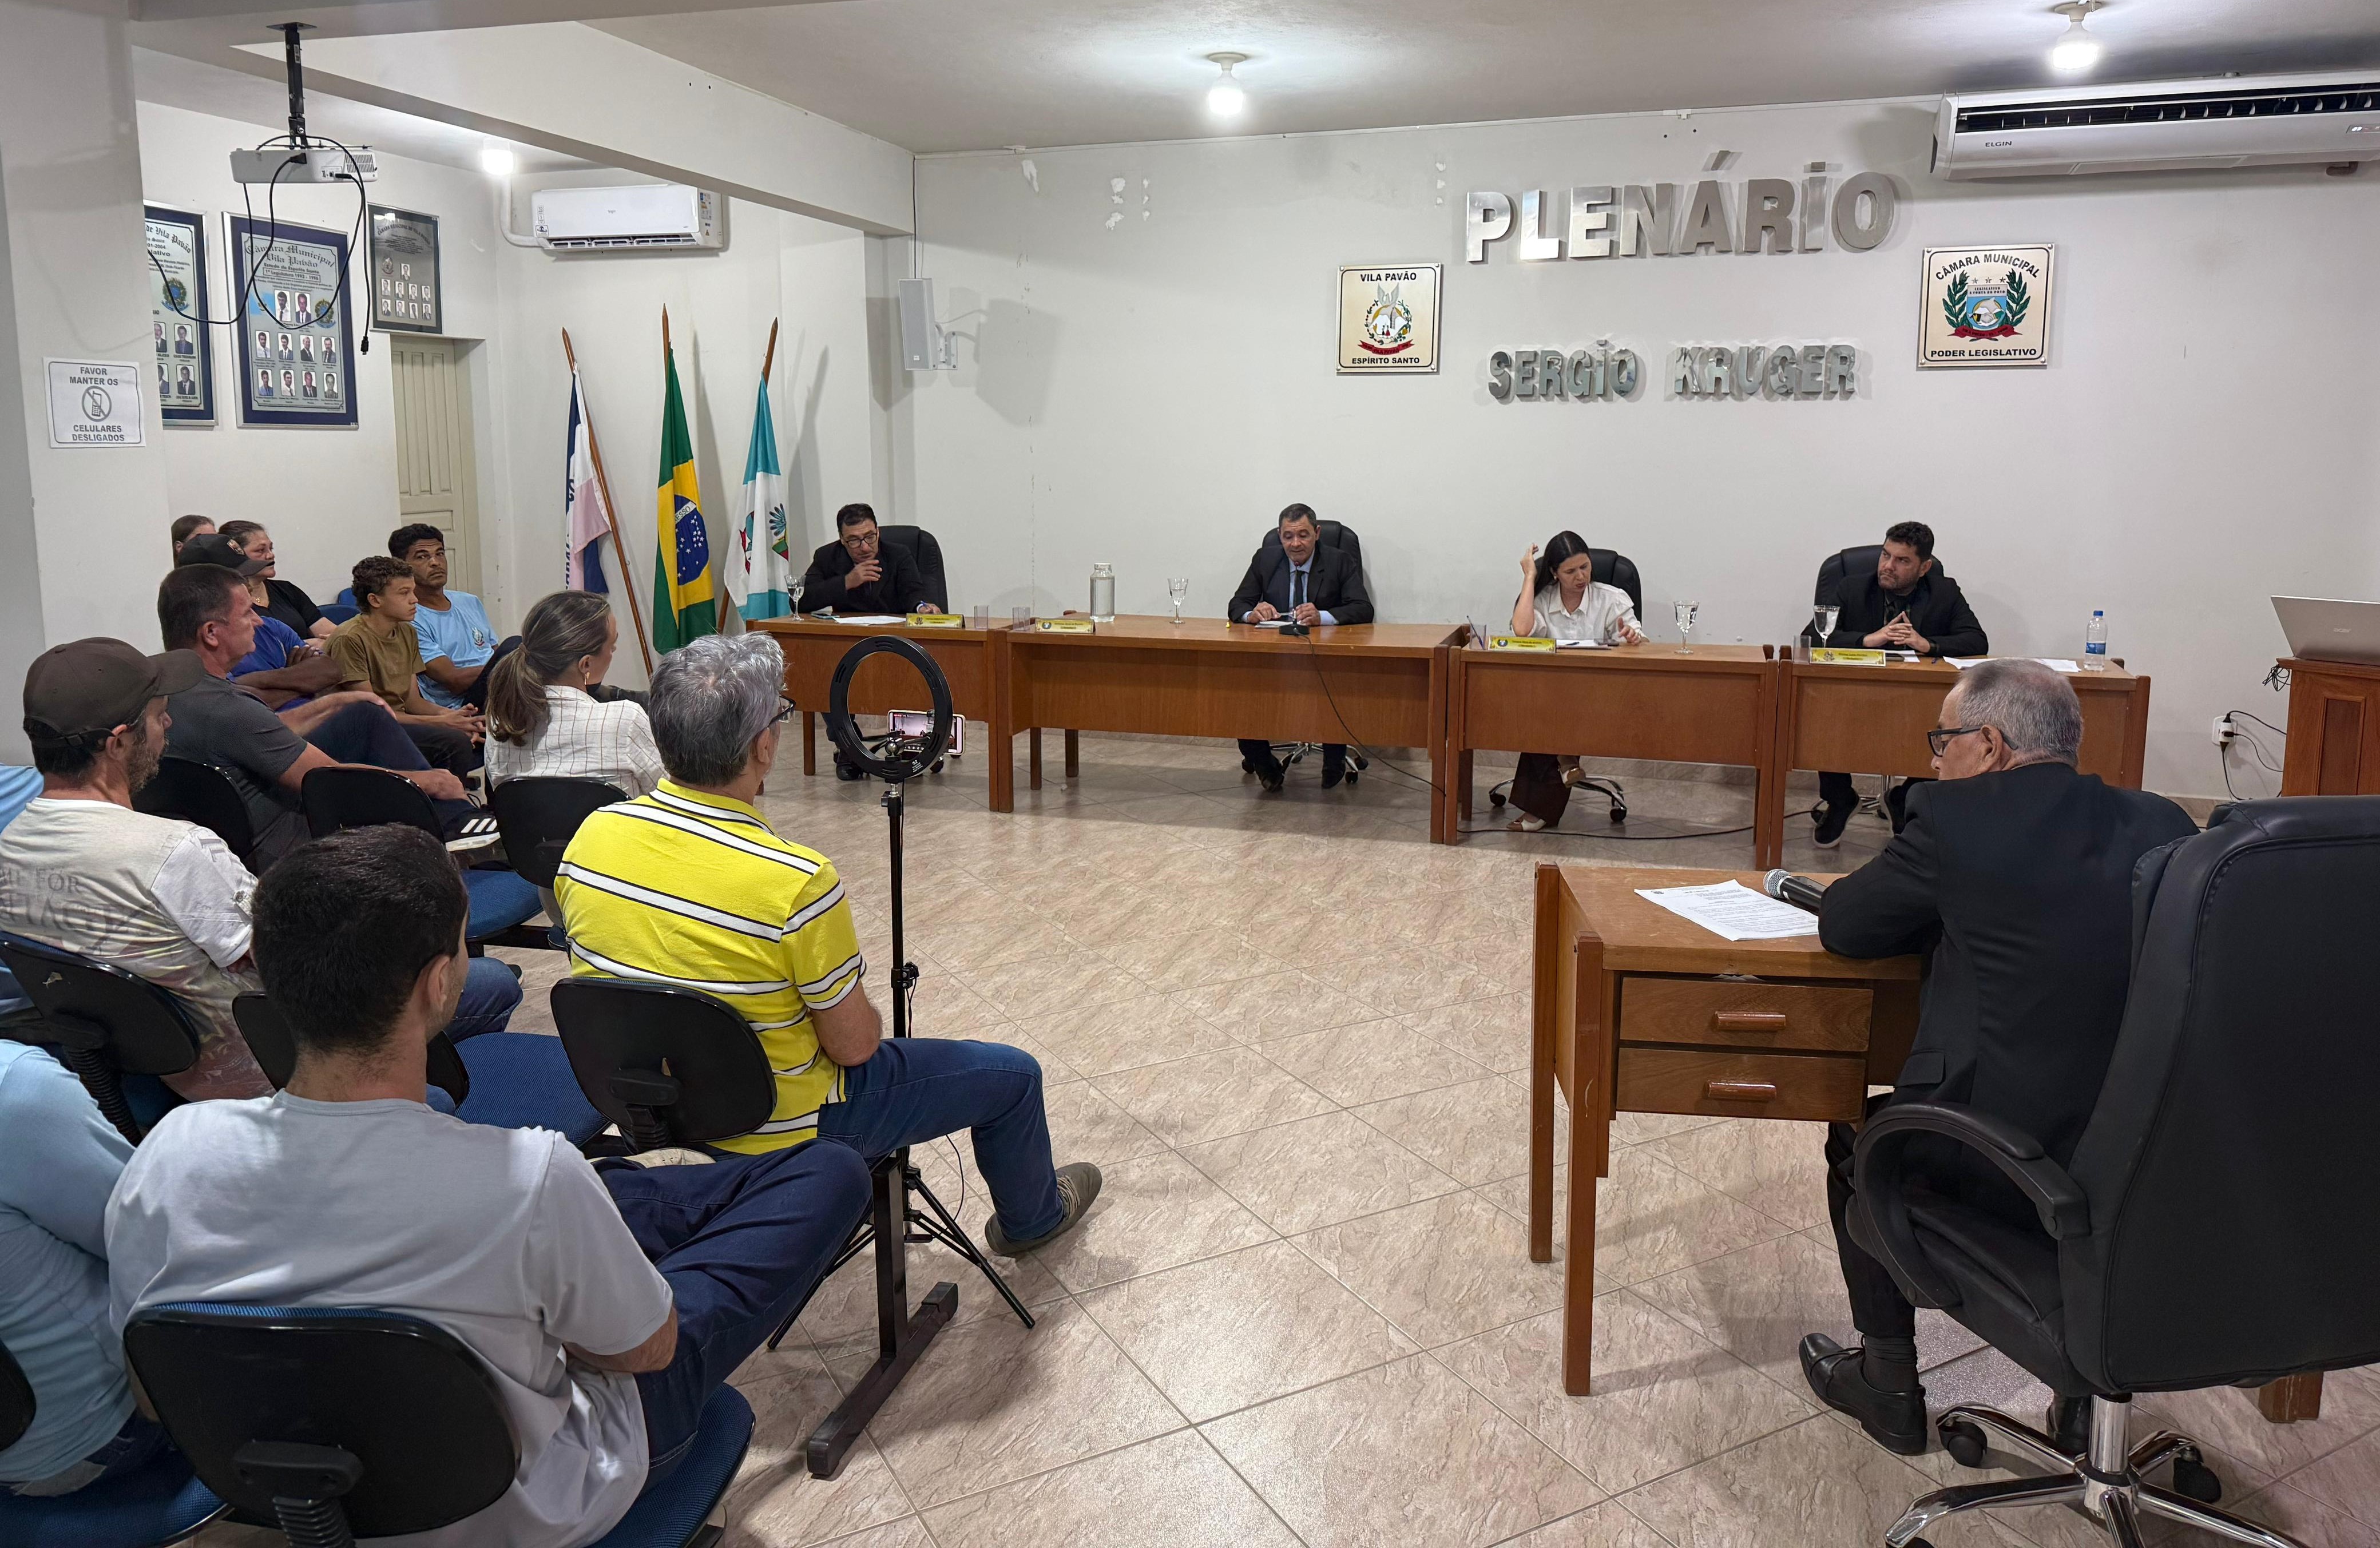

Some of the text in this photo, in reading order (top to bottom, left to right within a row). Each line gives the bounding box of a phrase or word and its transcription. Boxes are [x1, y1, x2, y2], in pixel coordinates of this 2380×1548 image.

[172, 234, 191, 253] Pavão
[1935, 254, 2040, 280] CÂMARA MUNICIPAL
[1360, 271, 1417, 282] VILA PAVÃO
[1931, 348, 2037, 358] PODER LEGISLATIVO
[80, 367, 107, 375] FAVOR
[1674, 344, 1857, 395] KRUGER
[70, 376, 105, 386] MANTER
[73, 424, 122, 432] CELULARES
[72, 434, 125, 442] DESLIGADOS
